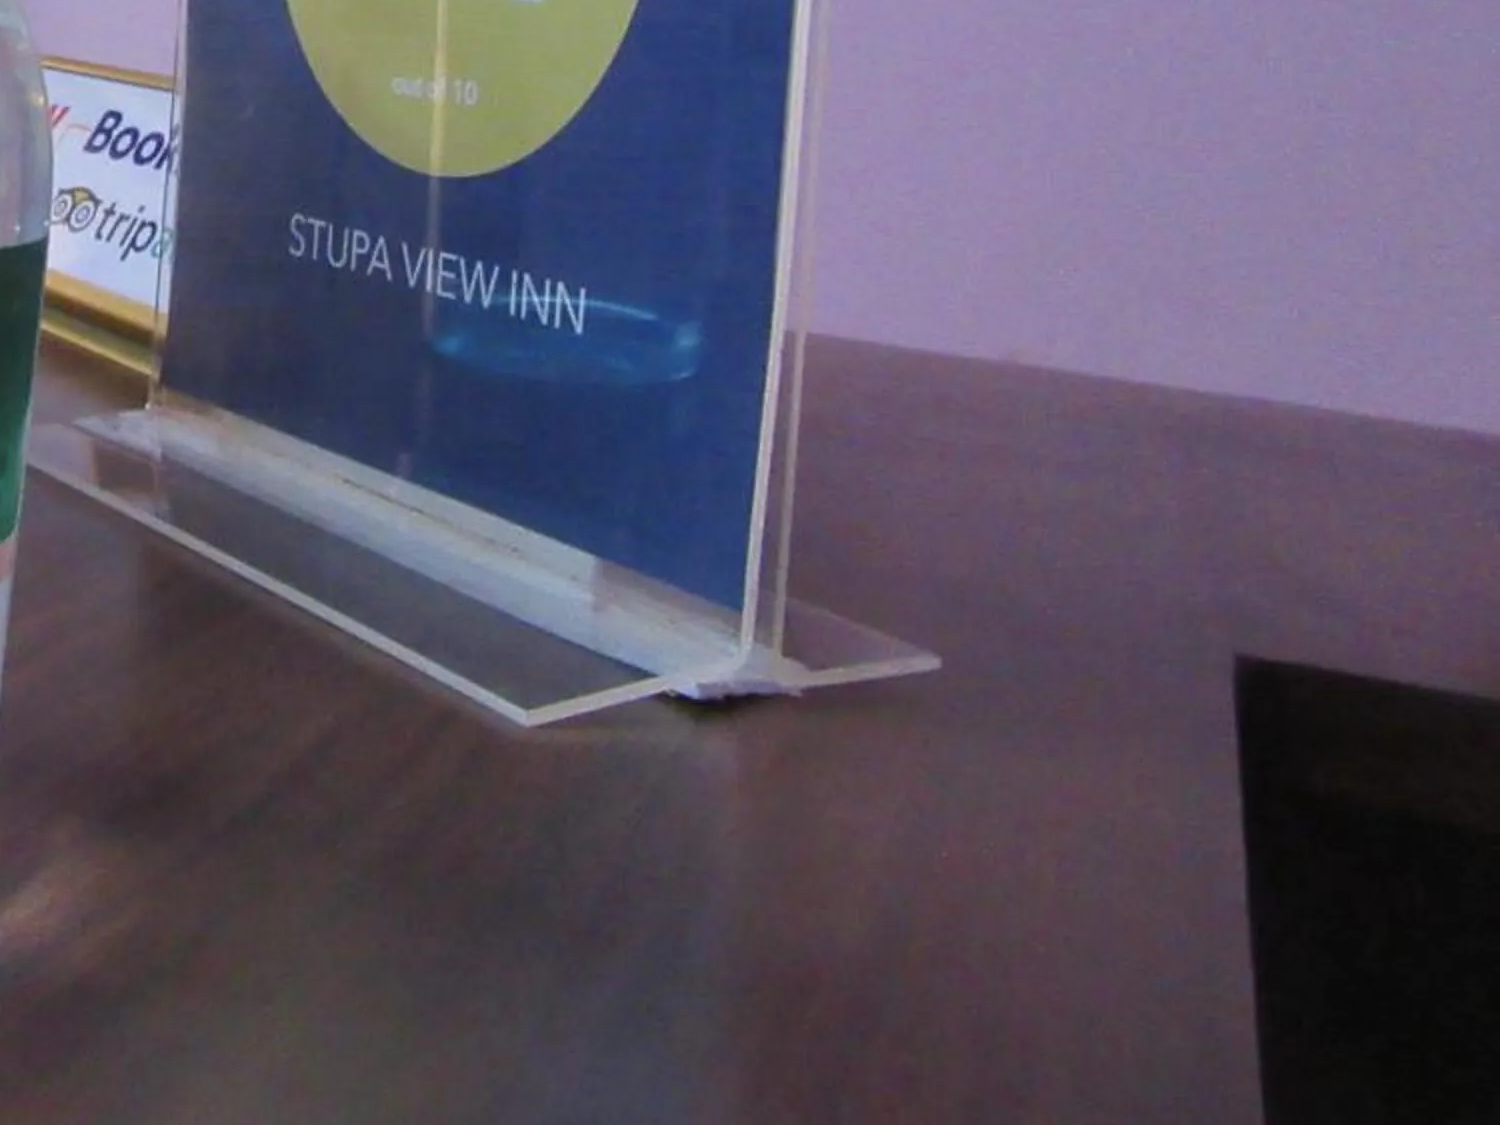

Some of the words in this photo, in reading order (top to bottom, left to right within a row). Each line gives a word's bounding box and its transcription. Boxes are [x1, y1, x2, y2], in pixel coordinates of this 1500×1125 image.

[454, 78, 480, 106] 10
[288, 212, 393, 282] STUPA
[399, 242, 502, 309] VIEW
[507, 271, 587, 335] INN
